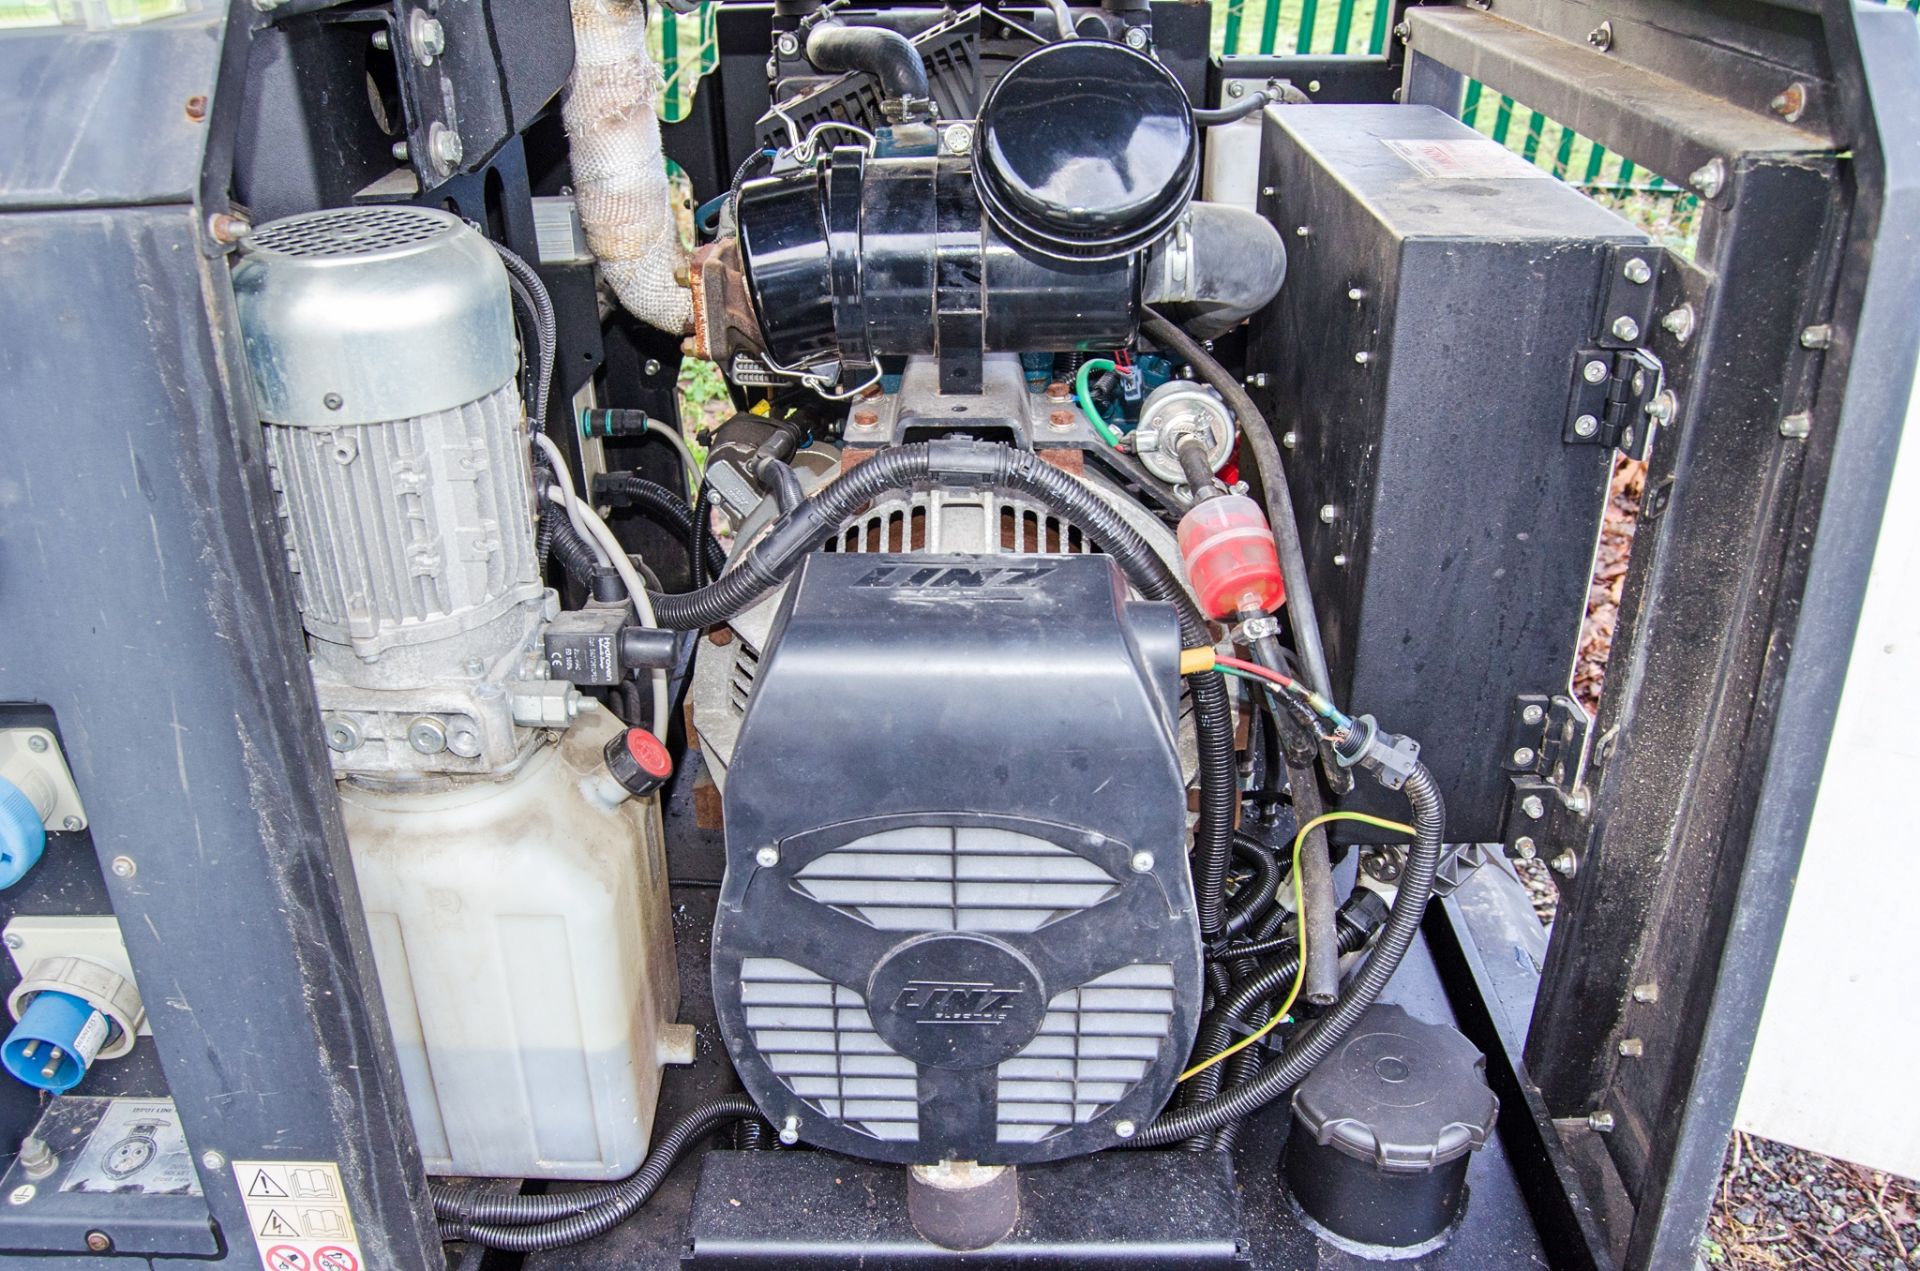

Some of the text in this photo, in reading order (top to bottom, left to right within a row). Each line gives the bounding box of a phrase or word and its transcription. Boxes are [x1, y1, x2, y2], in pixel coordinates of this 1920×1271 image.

[850, 567, 1058, 588] LINZ
[603, 637, 612, 682] Hydroven
[890, 988, 1023, 1012] LINZ
